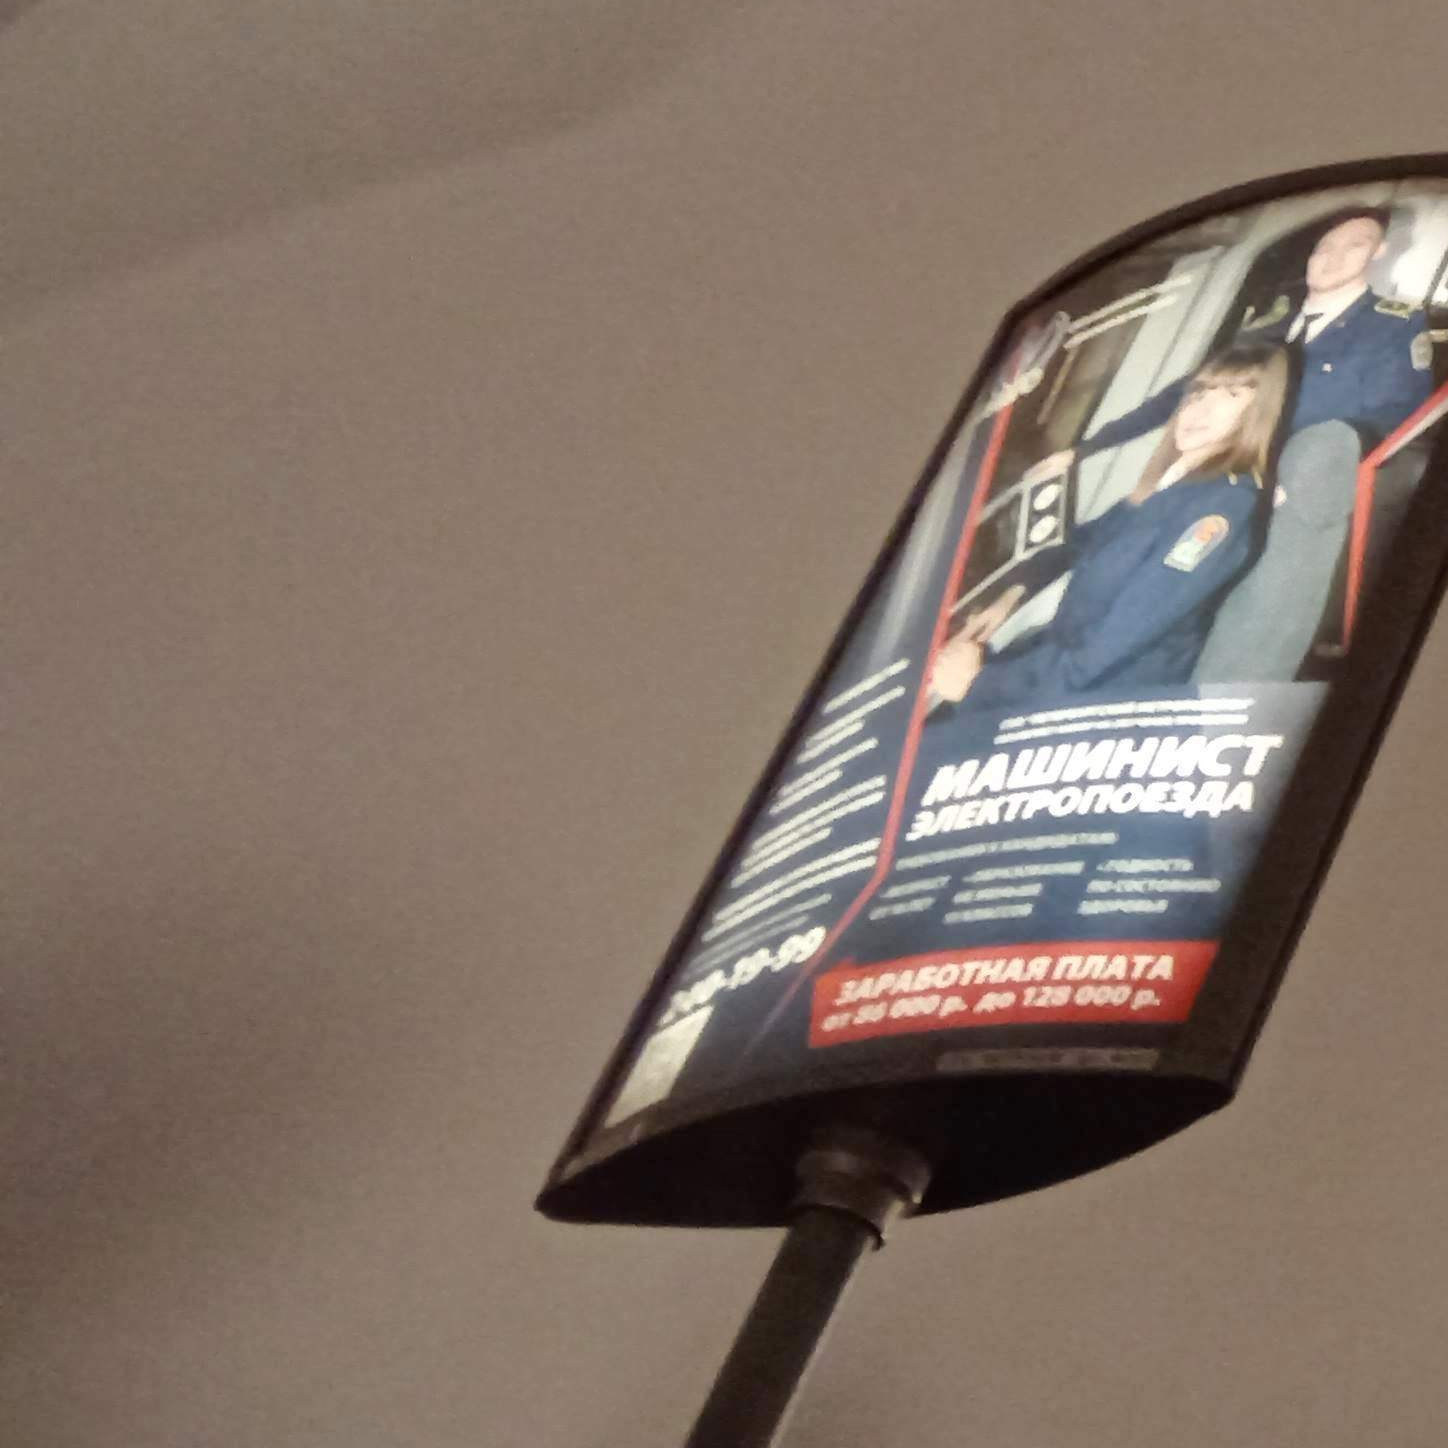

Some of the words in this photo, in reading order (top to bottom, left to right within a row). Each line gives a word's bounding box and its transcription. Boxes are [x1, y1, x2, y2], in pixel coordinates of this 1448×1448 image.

[920, 735, 1285, 808] МАШИНИСТ
[905, 781, 1256, 842] ЭЛЕКТРОПОЕЗДА
[833, 956, 1051, 1007] ЗАРАБОТНАЯ
[1052, 954, 1175, 982] ПЛАТА
